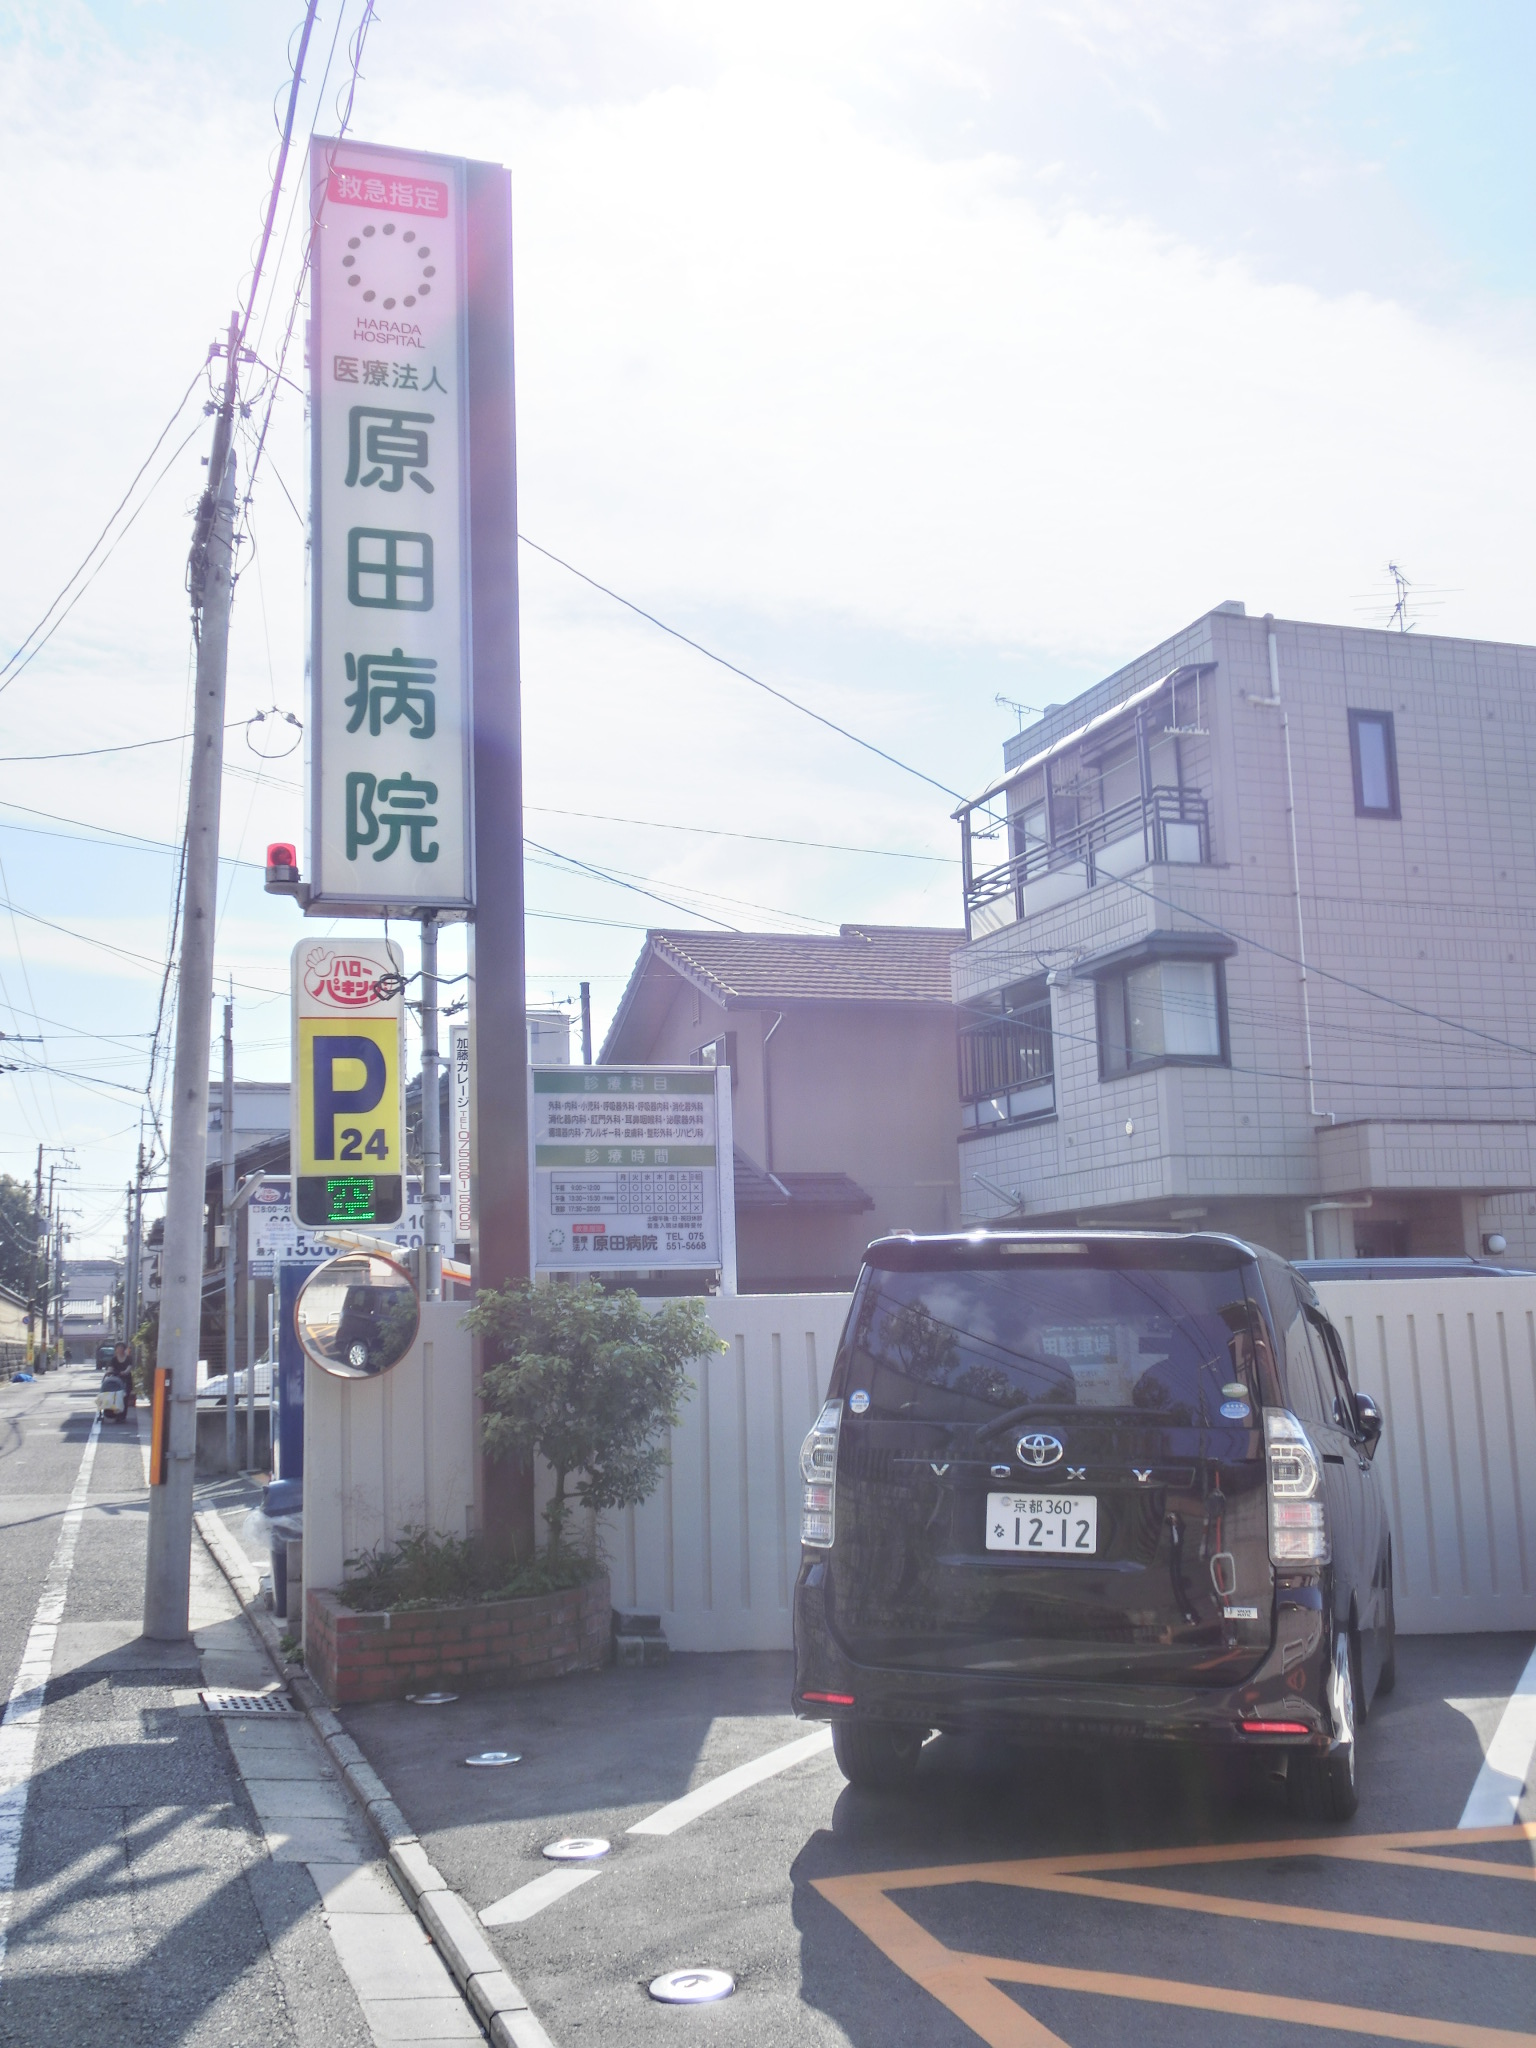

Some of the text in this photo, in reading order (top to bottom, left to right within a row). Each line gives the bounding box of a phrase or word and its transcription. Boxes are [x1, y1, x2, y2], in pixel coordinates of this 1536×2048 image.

[337, 176, 440, 212] 救急指定
[356, 316, 422, 335] HARADA
[353, 330, 426, 349] HOSPITAL
[333, 355, 448, 394] 医療法人
[344, 405, 440, 864] 原田病院
[333, 960, 373, 978] ハロー
[456, 1037, 470, 1108] 加藤ガレージ
[583, 1075, 668, 1091] 診療科目
[312, 1035, 387, 1161] P
[340, 1128, 389, 1161] 24
[584, 1148, 669, 1164] 診療時間
[620, 1173, 627, 1181] 月
[632, 1173, 639, 1181] 火
[644, 1173, 651, 1181] 水
[656, 1173, 663, 1181] 木
[668, 1173, 675, 1181] 金
[680, 1173, 688, 1181] 土
[327, 1177, 375, 1221] 空
[593, 1235, 658, 1251] 原田病院
[666, 1232, 704, 1241] TEL 075
[666, 1242, 707, 1250] 551-5668
[930, 1463, 1153, 1482] VOXY
[993, 1517, 1091, 1549] な 12-12
